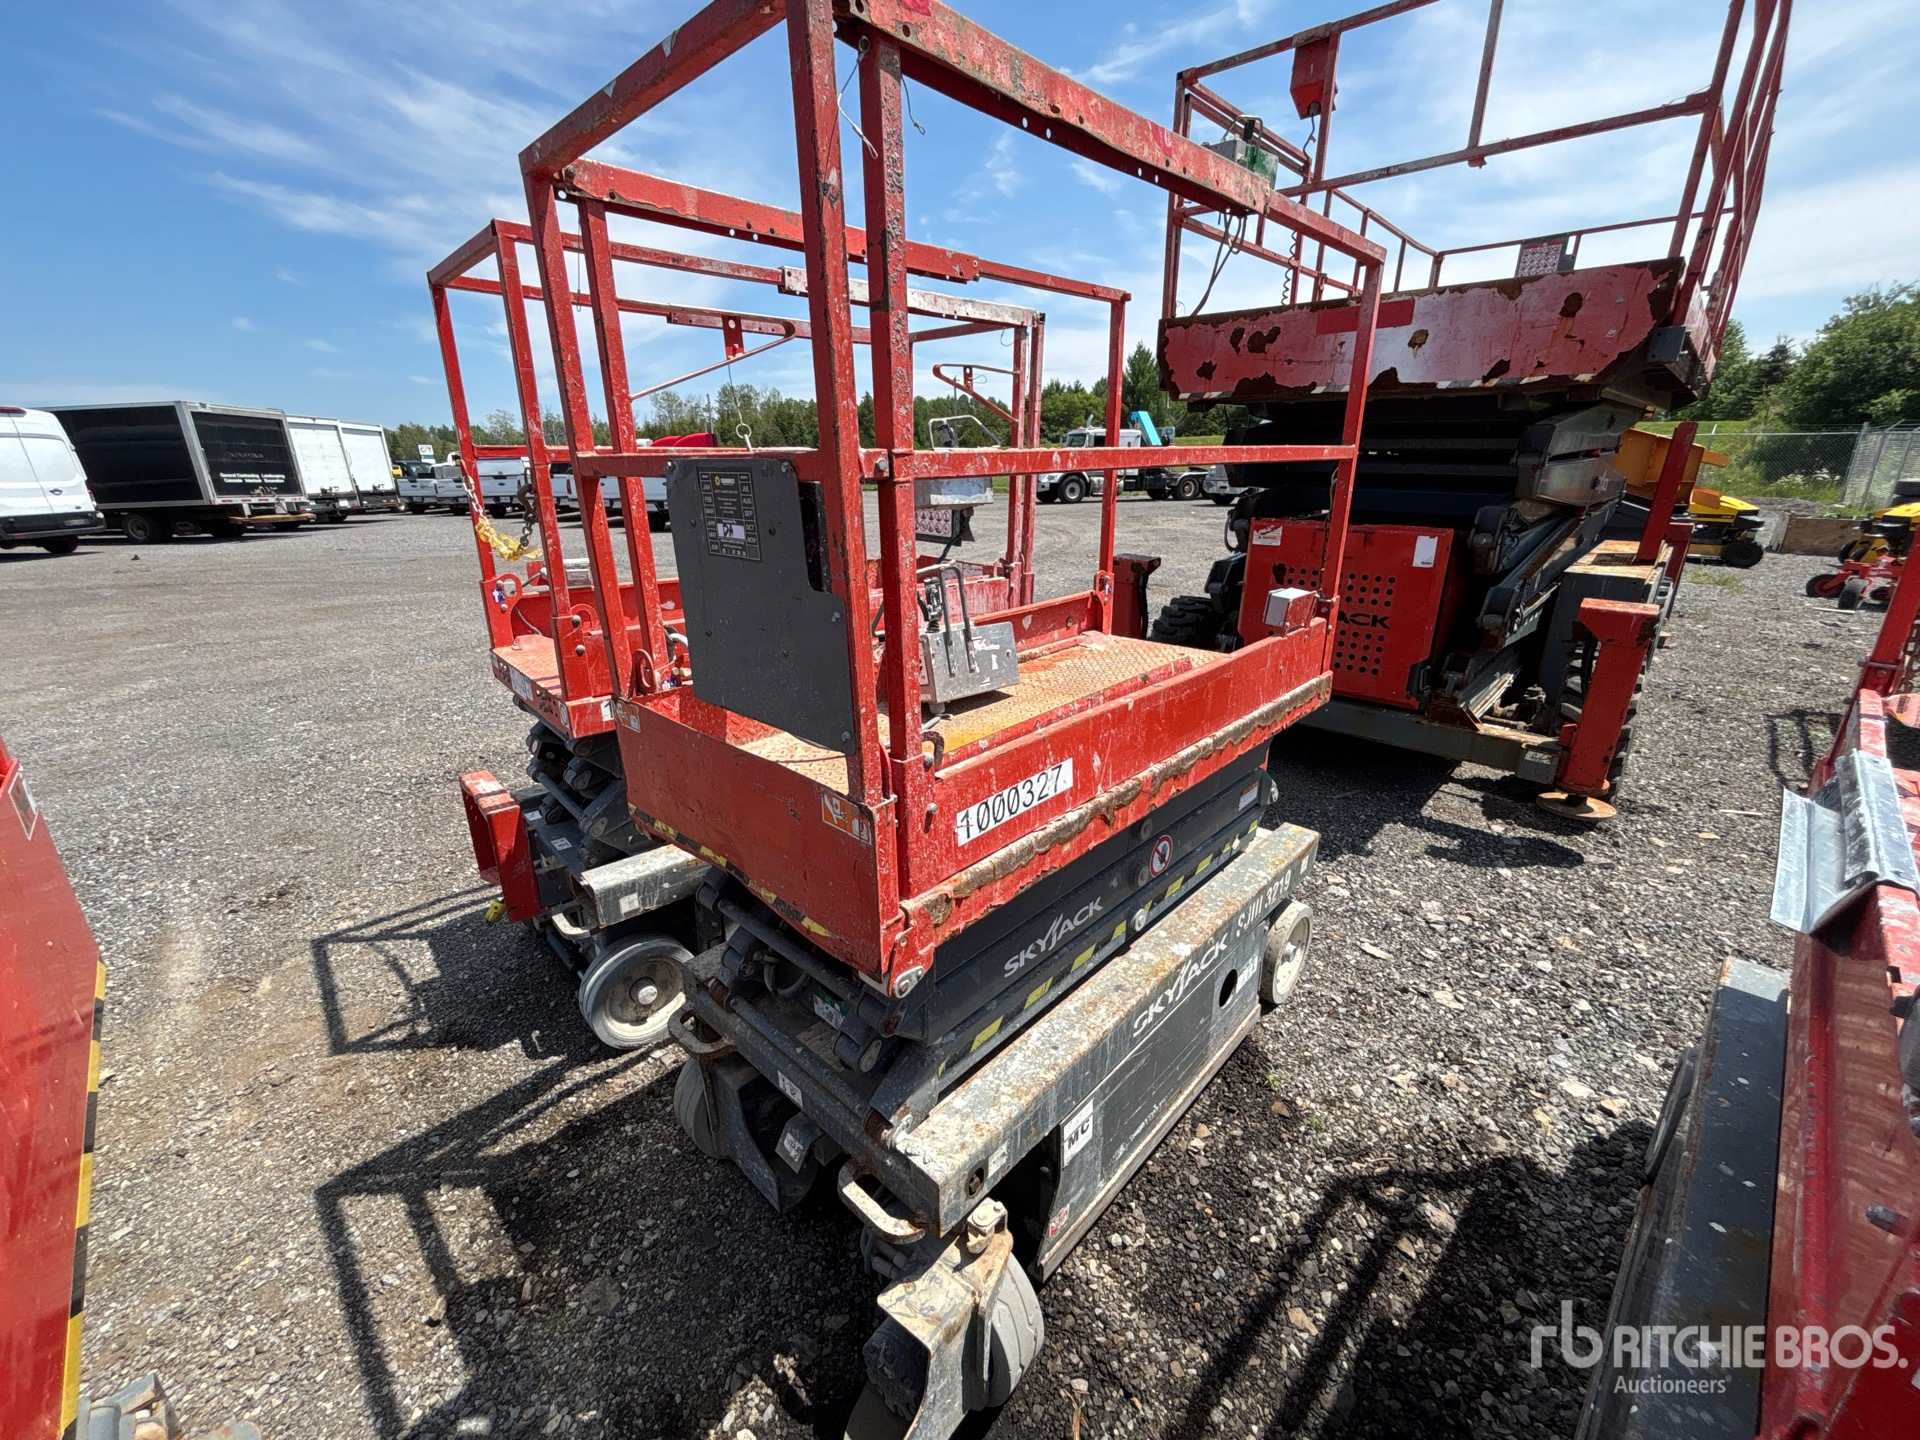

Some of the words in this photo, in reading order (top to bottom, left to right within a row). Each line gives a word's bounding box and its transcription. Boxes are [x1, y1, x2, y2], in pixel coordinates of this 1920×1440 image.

[961, 763, 1063, 839] 1000327
[1003, 896, 1103, 978] SKYJACK
[1133, 932, 1228, 1038] SKYJACK
[1067, 1118, 1091, 1150] MC
